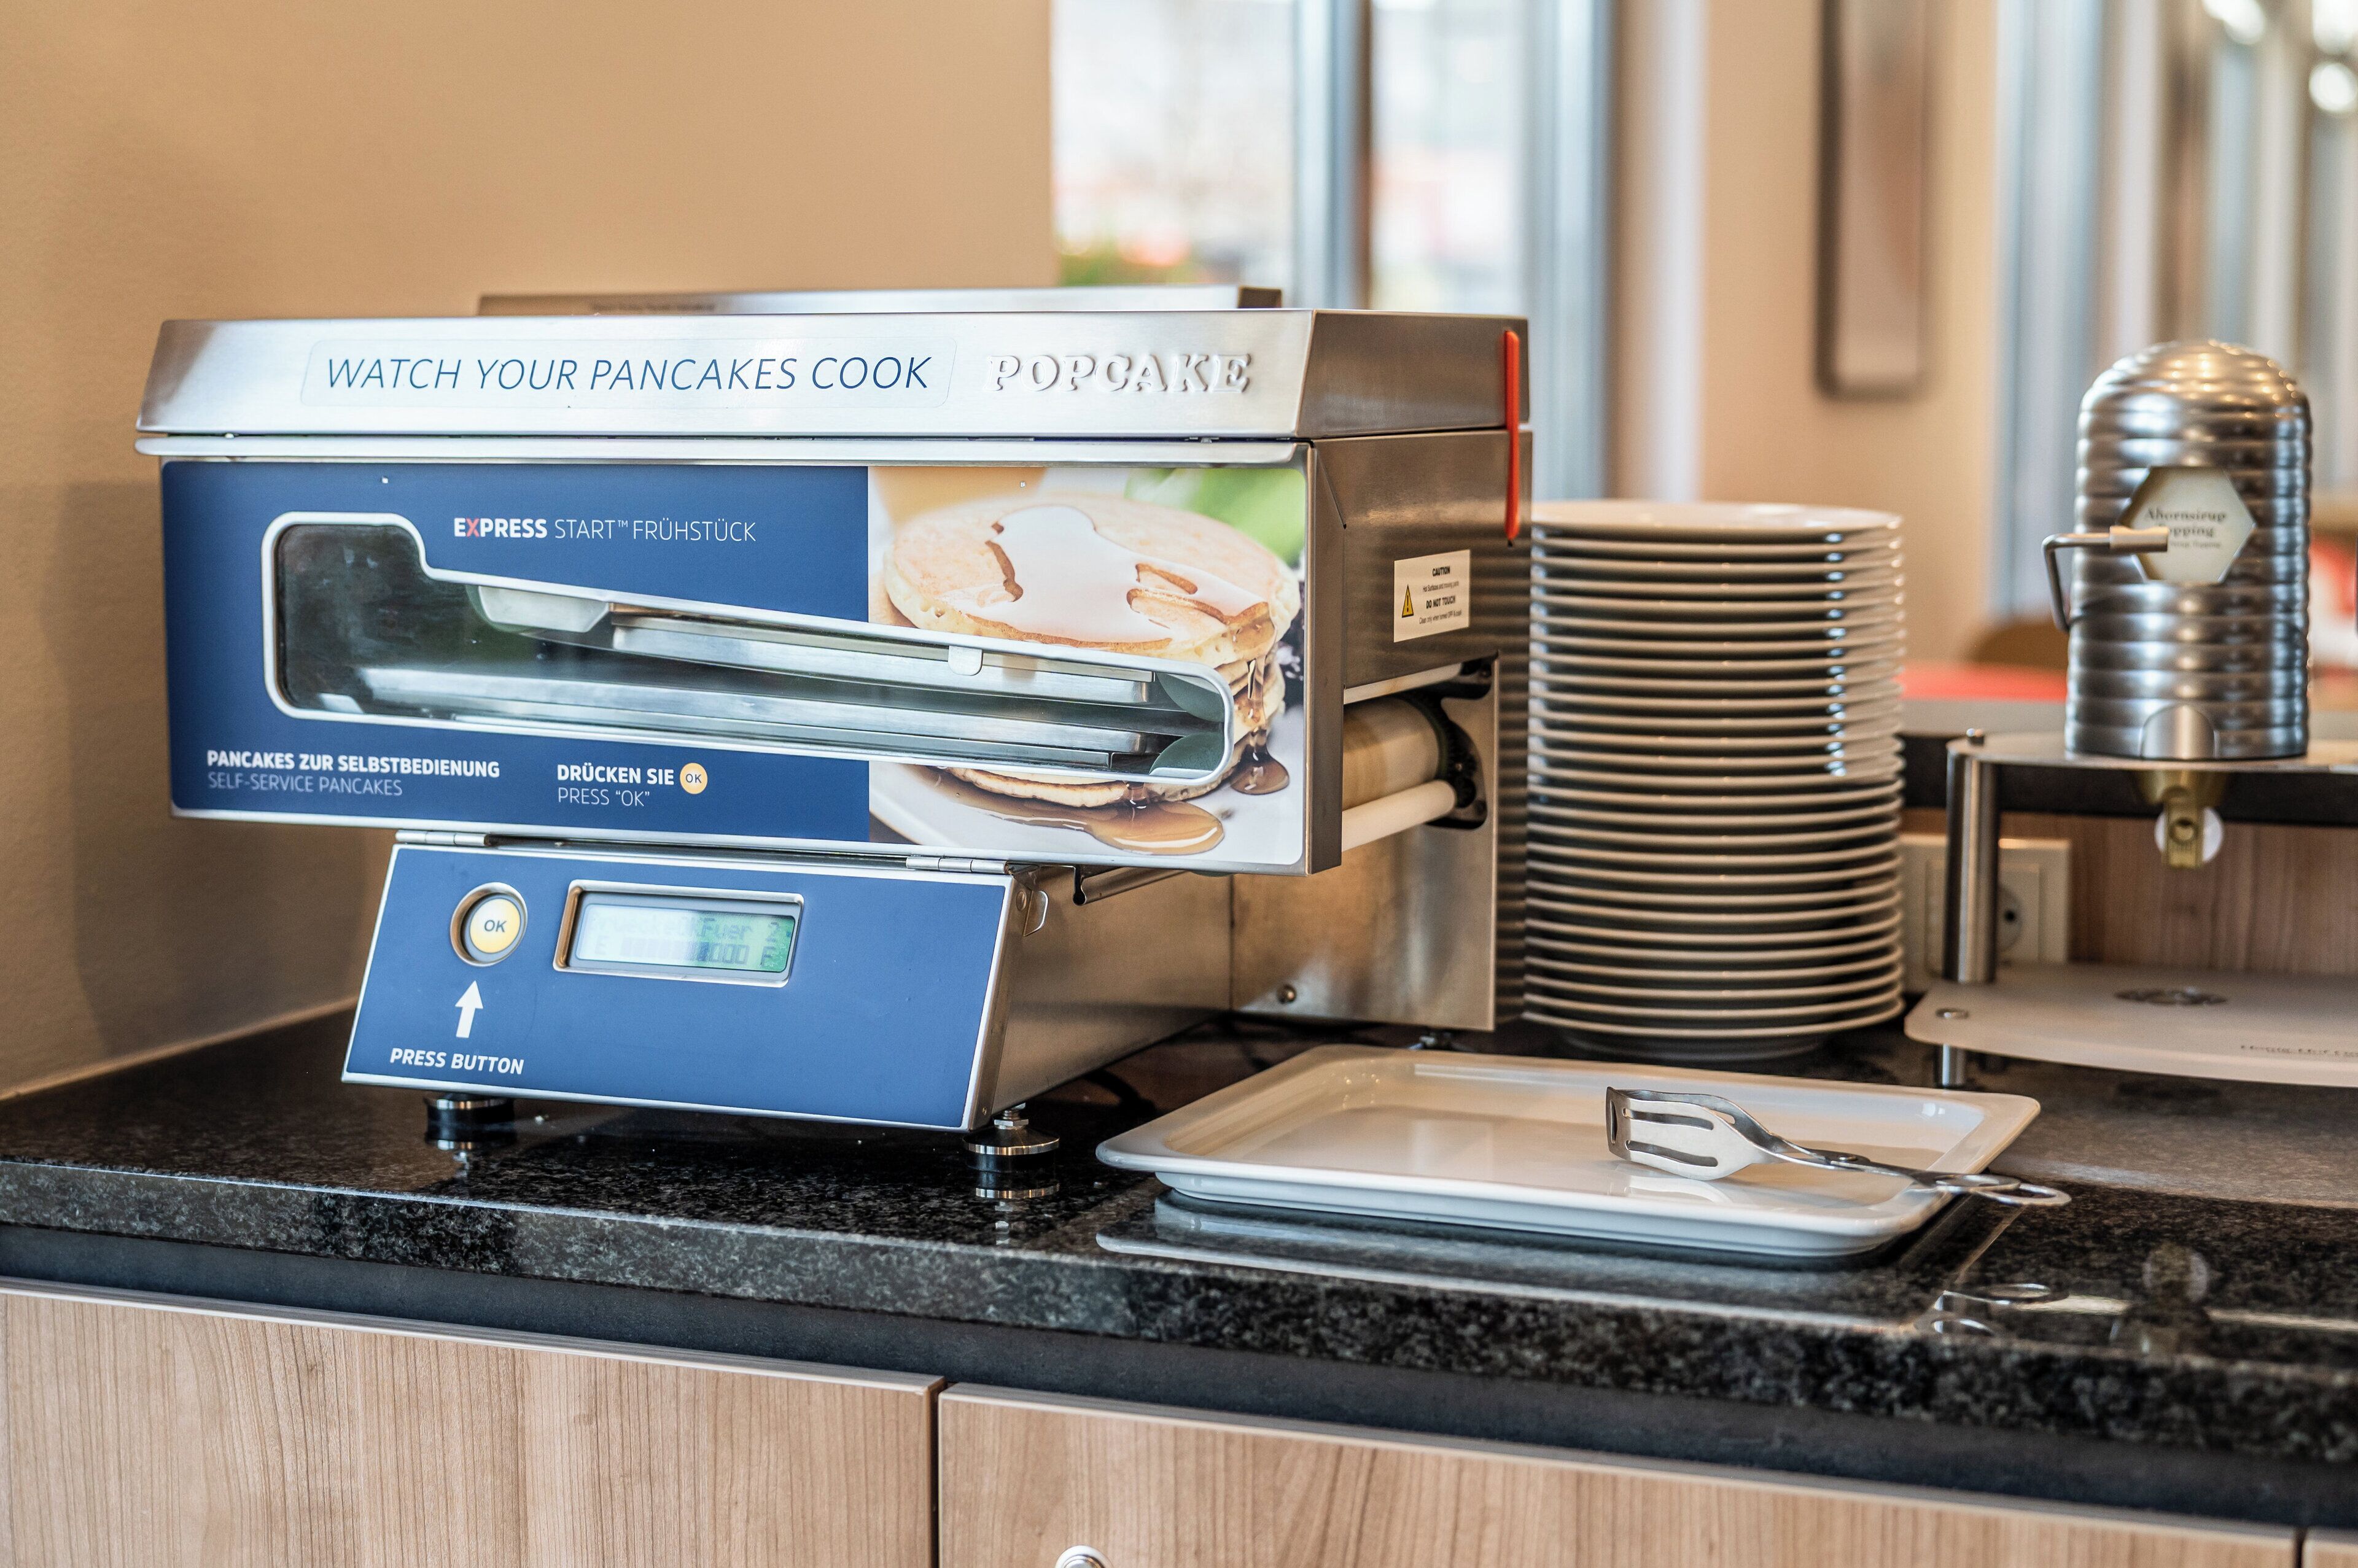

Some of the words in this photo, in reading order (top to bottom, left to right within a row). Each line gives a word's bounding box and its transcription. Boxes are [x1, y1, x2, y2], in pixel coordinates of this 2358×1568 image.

[328, 358, 462, 390] WATCH
[477, 359, 578, 390] YOUR
[590, 357, 798, 391] PANCAKES
[811, 356, 933, 390] COOK
[984, 353, 1253, 393] POPCAKE
[454, 517, 548, 538] EXPRESS
[633, 517, 757, 541] FRÜHSTÜCK
[1432, 565, 1450, 576] CAUTION
[1426, 600, 1432, 609] DO
[1433, 598, 1441, 608] NOT
[1442, 595, 1456, 606] TOUCH
[208, 750, 295, 769] PANCAKES
[299, 754, 333, 770] ZUR
[338, 755, 500, 777] SELBSTBEDIENUNG
[557, 762, 641, 784] DRÜCKEN
[647, 767, 674, 785] SIE
[685, 773, 702, 783] OK
[209, 772, 314, 792] SELF-SERVICE
[319, 776, 403, 796] PANCAKES
[558, 786, 610, 805] PRESS
[484, 920, 506, 933] OK
[389, 1047, 446, 1068] PRESS
[451, 1052, 524, 1075] BUTTON
